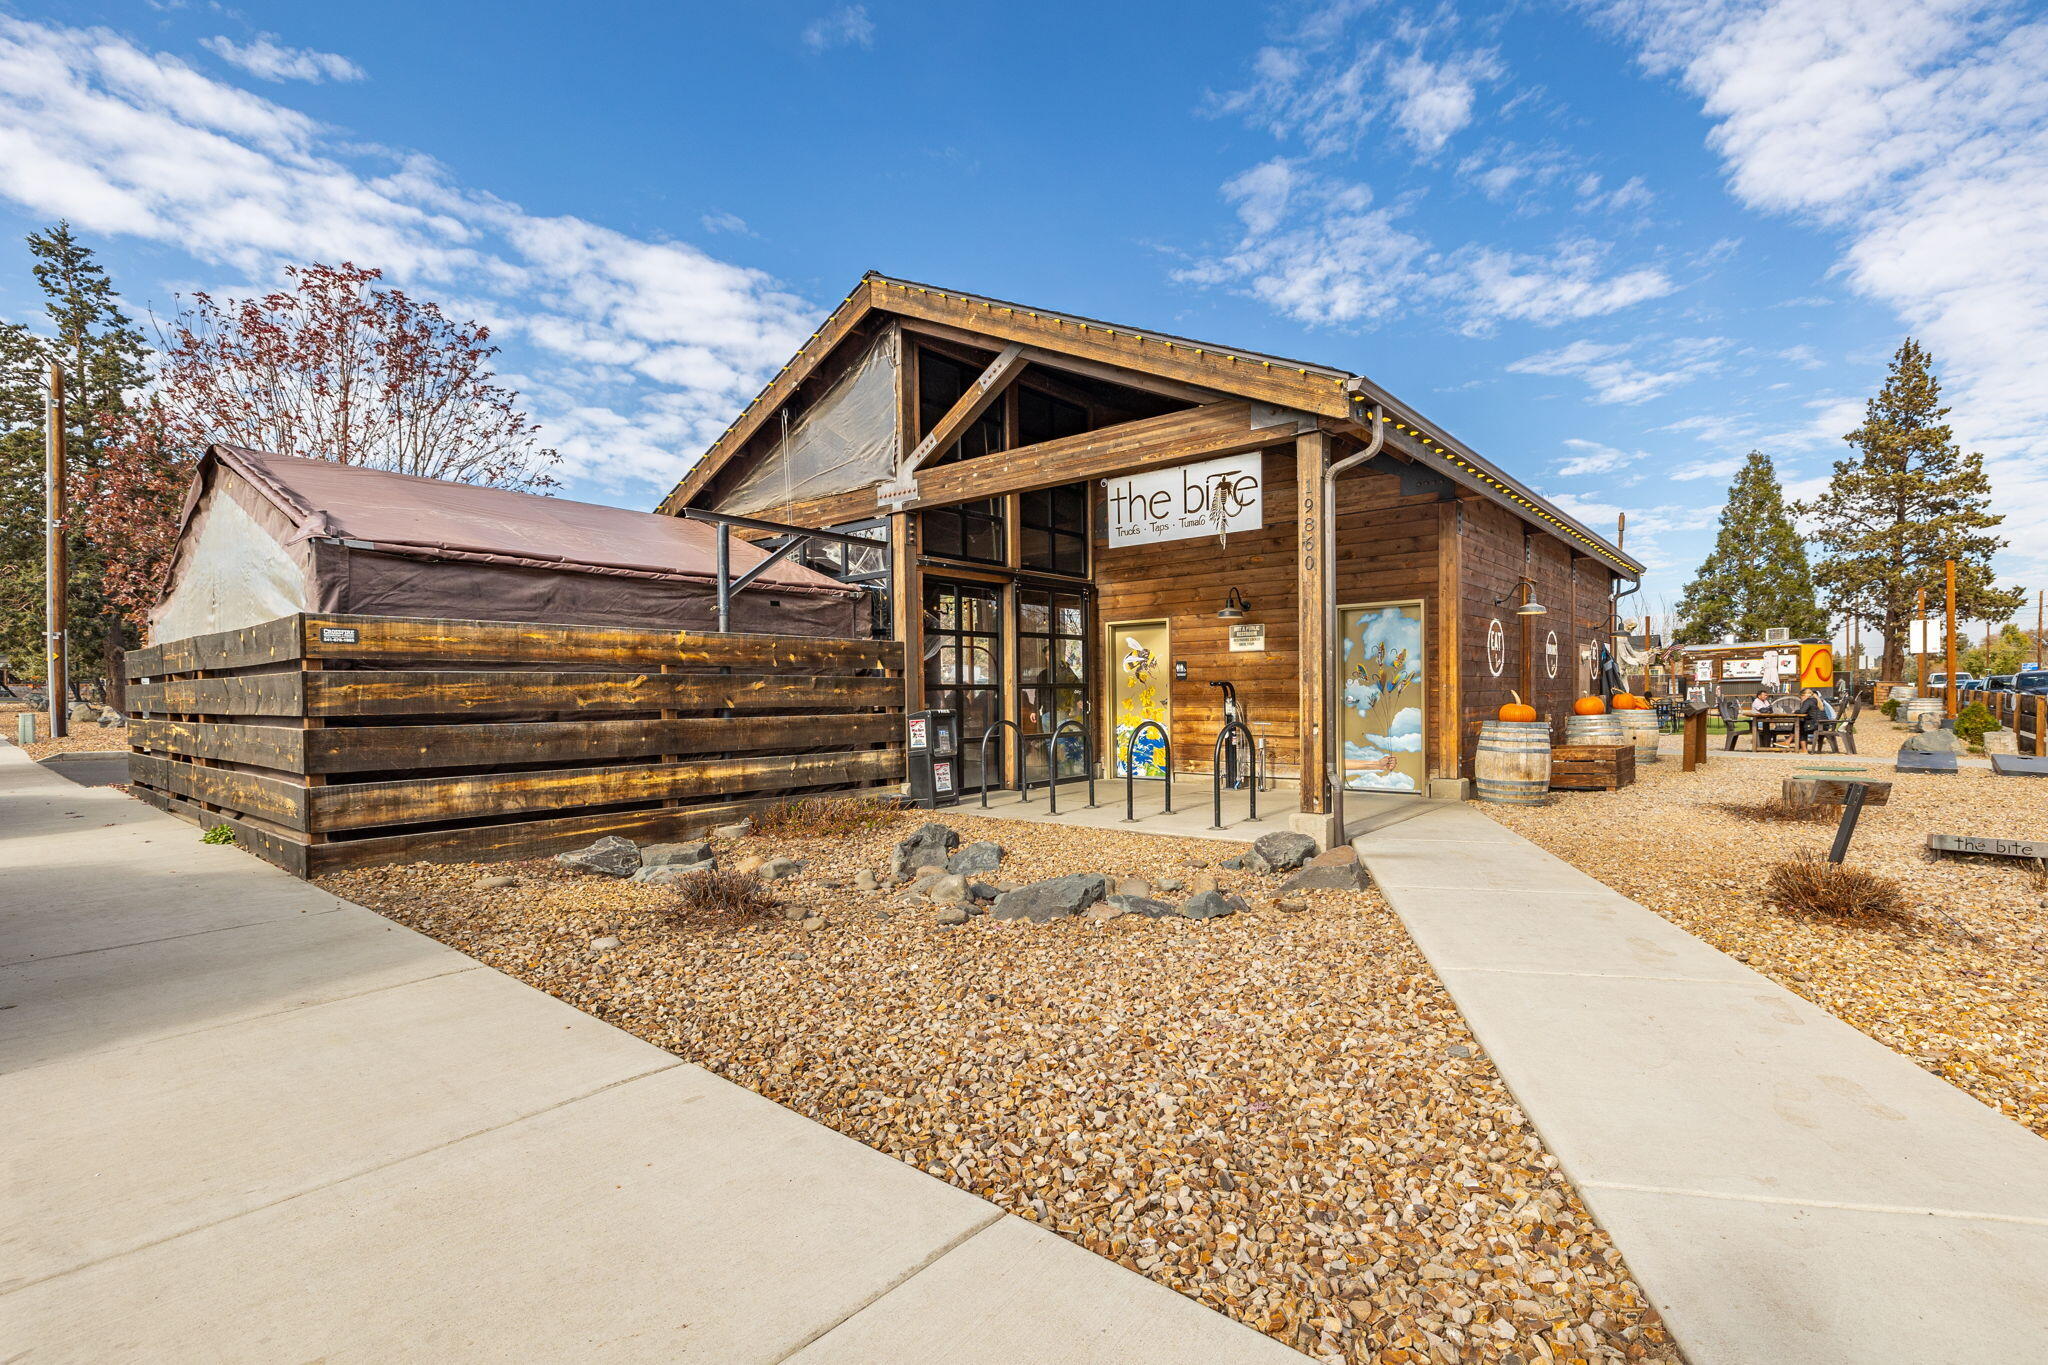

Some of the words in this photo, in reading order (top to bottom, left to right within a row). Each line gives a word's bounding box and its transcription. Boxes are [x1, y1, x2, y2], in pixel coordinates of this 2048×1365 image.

[1110, 481, 1171, 525] the
[1184, 469, 1258, 517] bite
[1115, 524, 1141, 537] Trucks
[1149, 521, 1169, 536] Taps
[1178, 514, 1206, 529] Tumalo
[1304, 480, 1315, 571] 19860
[1491, 630, 1502, 652] EAT
[1954, 837, 1986, 852] the
[1996, 840, 2033, 856] bite
